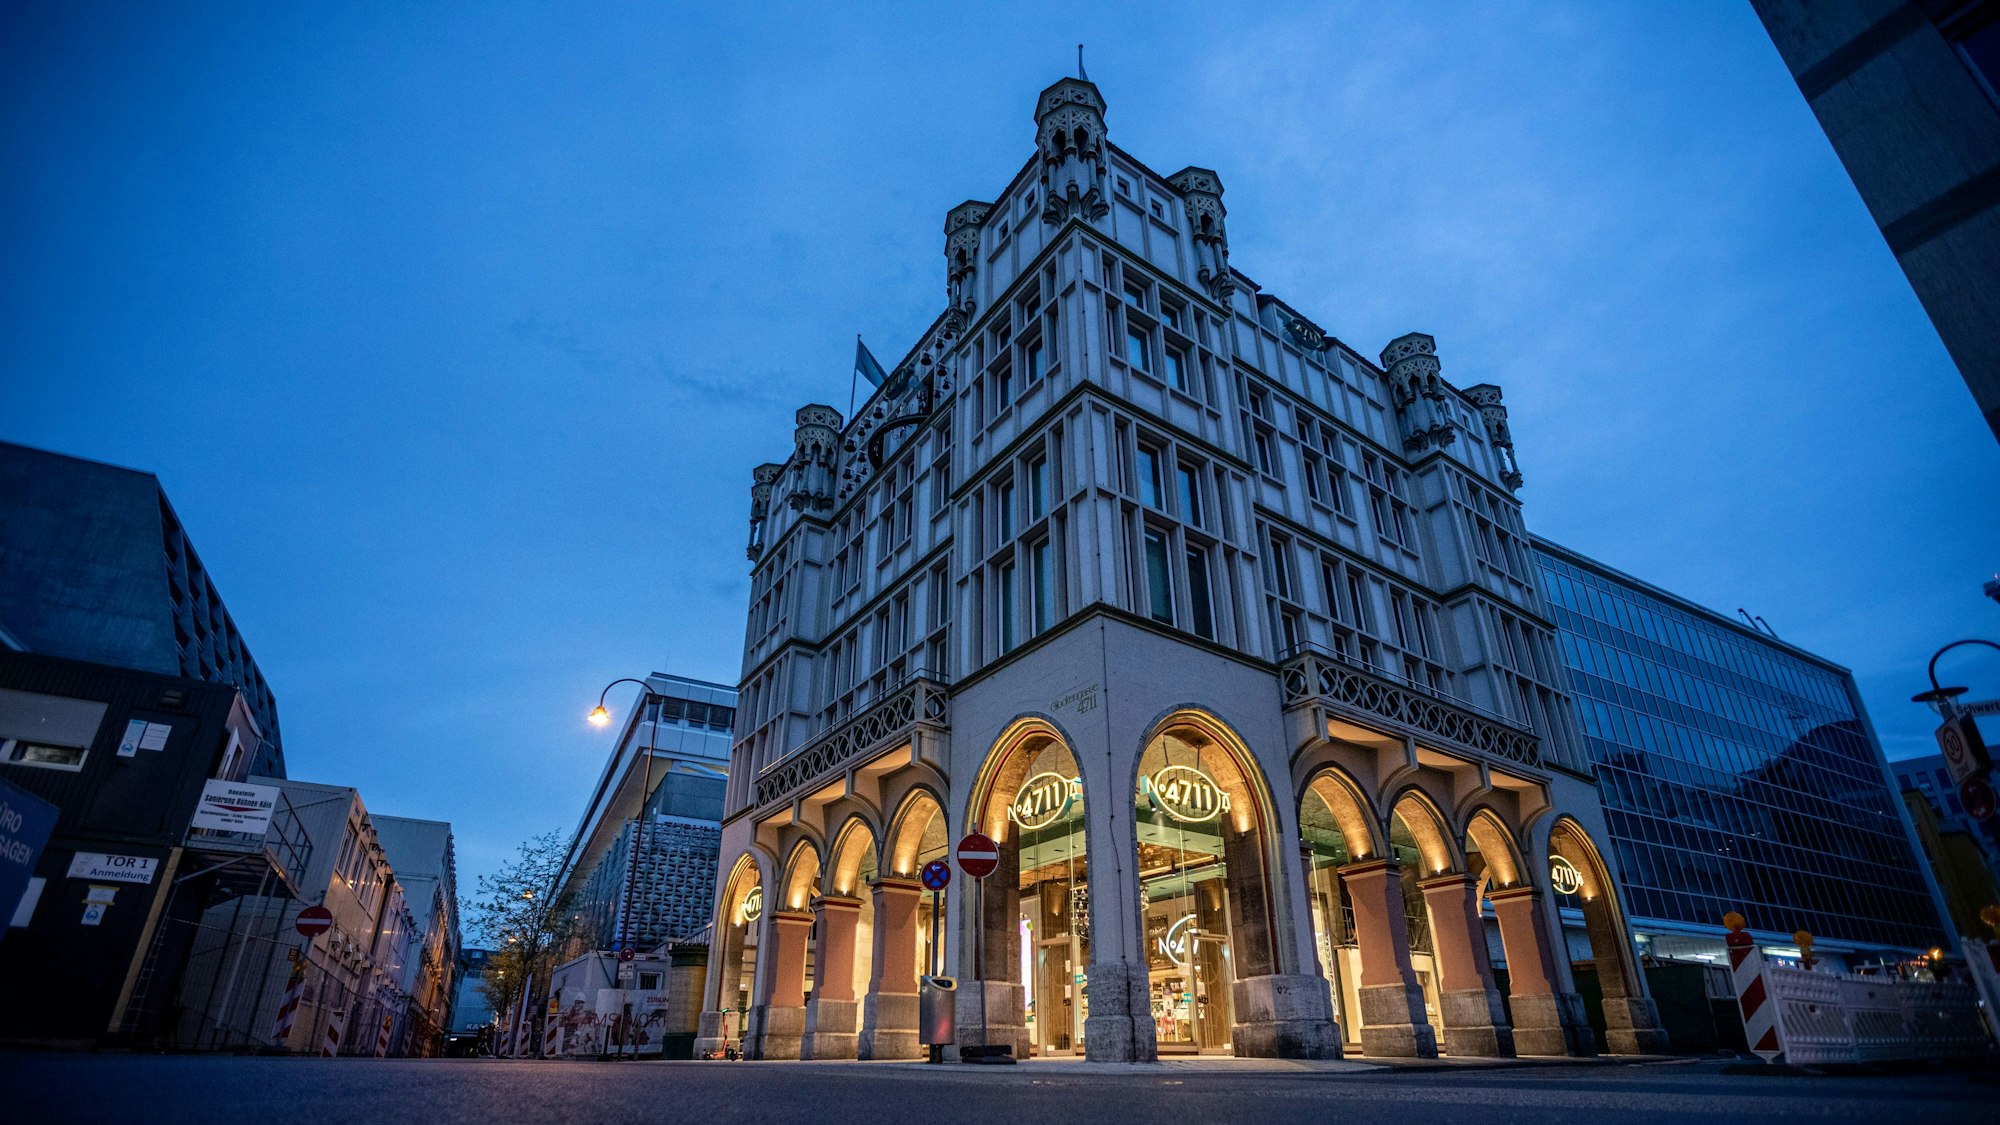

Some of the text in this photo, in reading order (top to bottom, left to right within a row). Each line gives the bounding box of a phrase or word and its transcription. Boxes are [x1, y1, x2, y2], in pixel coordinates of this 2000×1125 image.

[1077, 693, 1098, 714] 4711
[1946, 735, 1960, 755] 30
[204, 794, 236, 805] Sanierung
[106, 855, 136, 869] TOR
[140, 859, 148, 869] 1
[89, 868, 150, 881] Anmeldung
